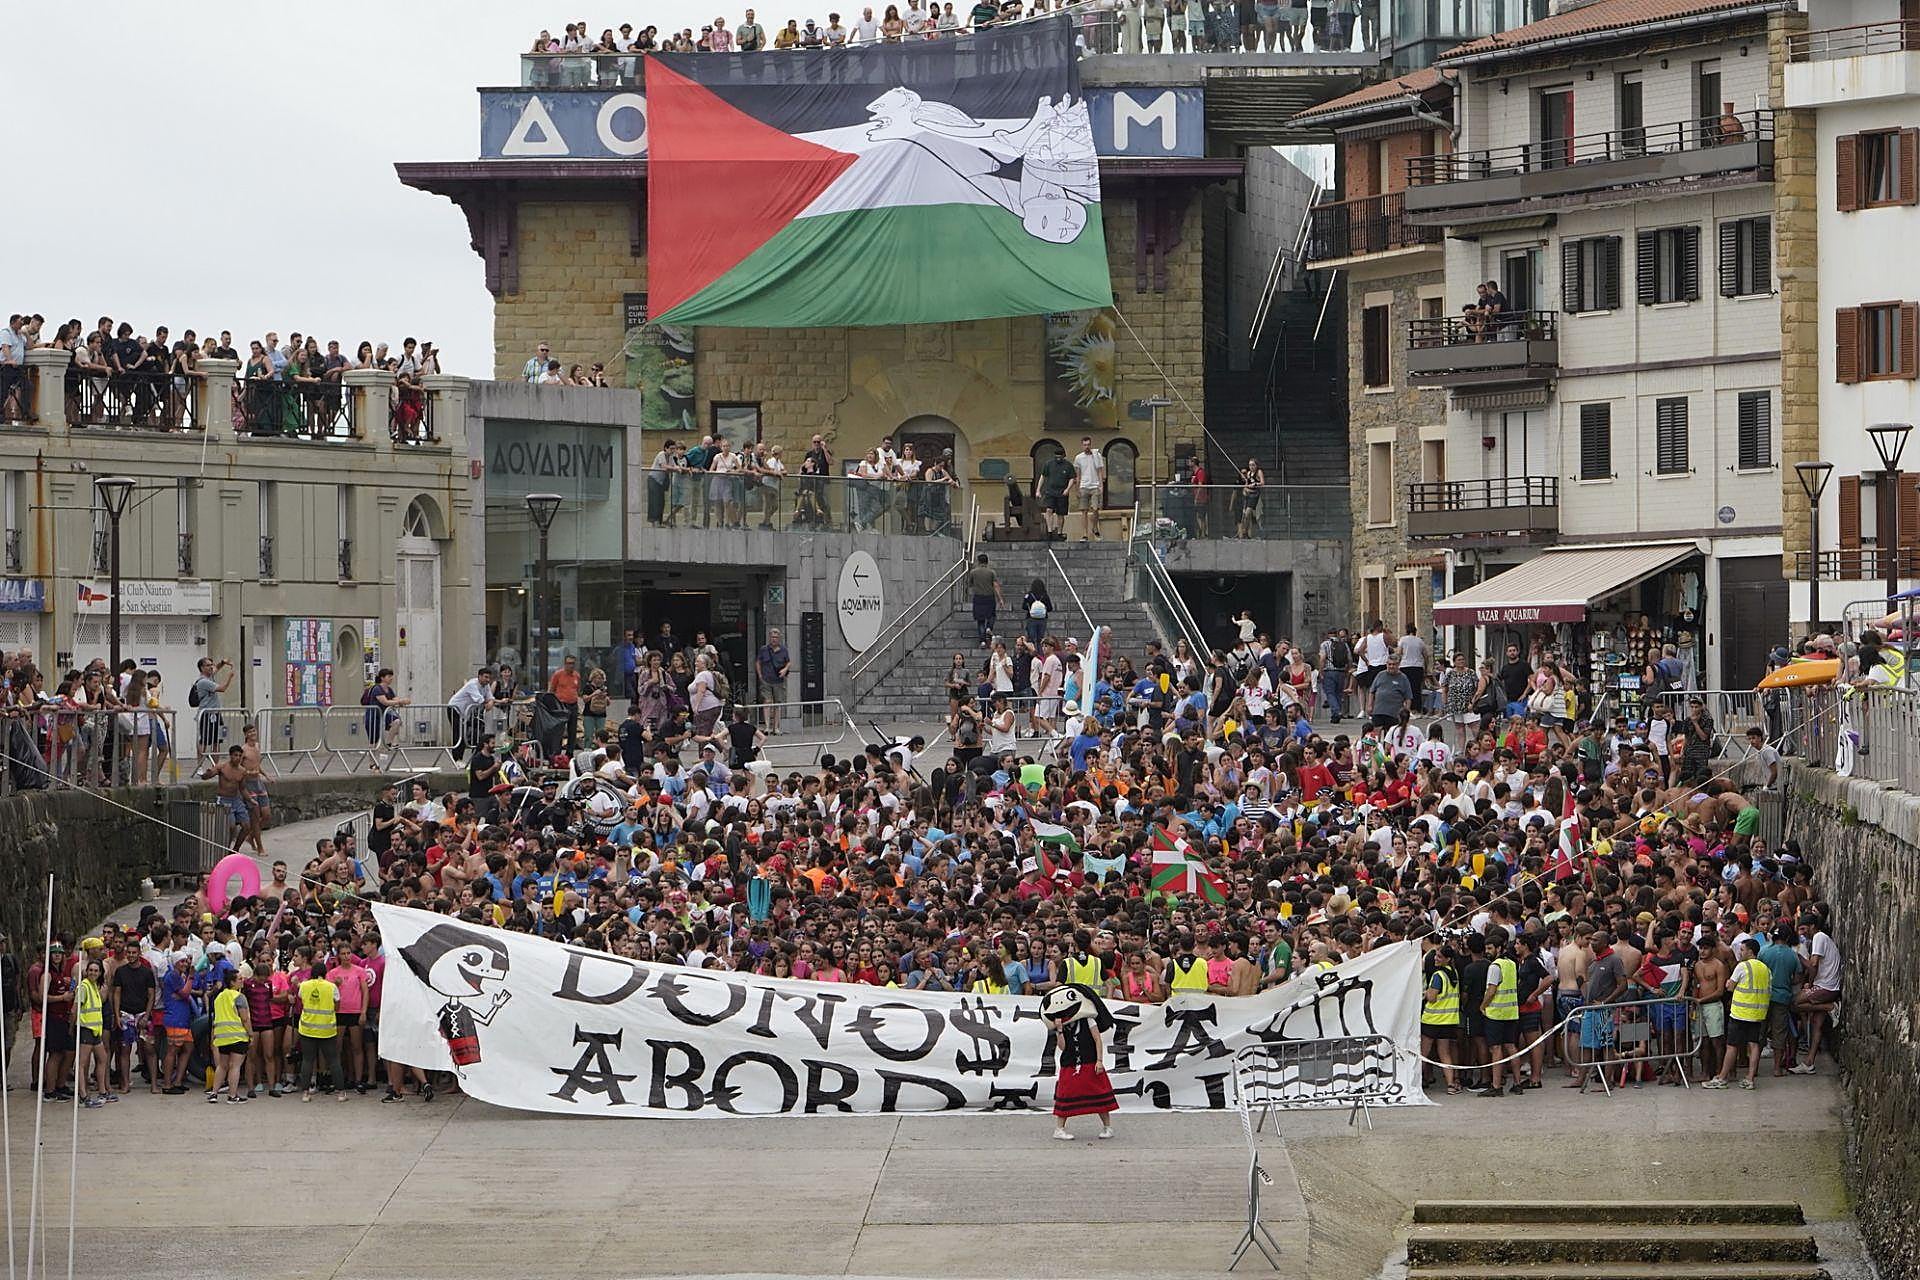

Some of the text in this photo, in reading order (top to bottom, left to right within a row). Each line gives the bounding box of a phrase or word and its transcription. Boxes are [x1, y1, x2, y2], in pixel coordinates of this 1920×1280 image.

[126, 582, 144, 596] Club
[144, 582, 173, 596] Náutico
[126, 600, 138, 612] San
[140, 599, 173, 613] Sebastián
[1503, 608, 1540, 622] AQUARIUM
[1427, 749, 1445, 762] 13
